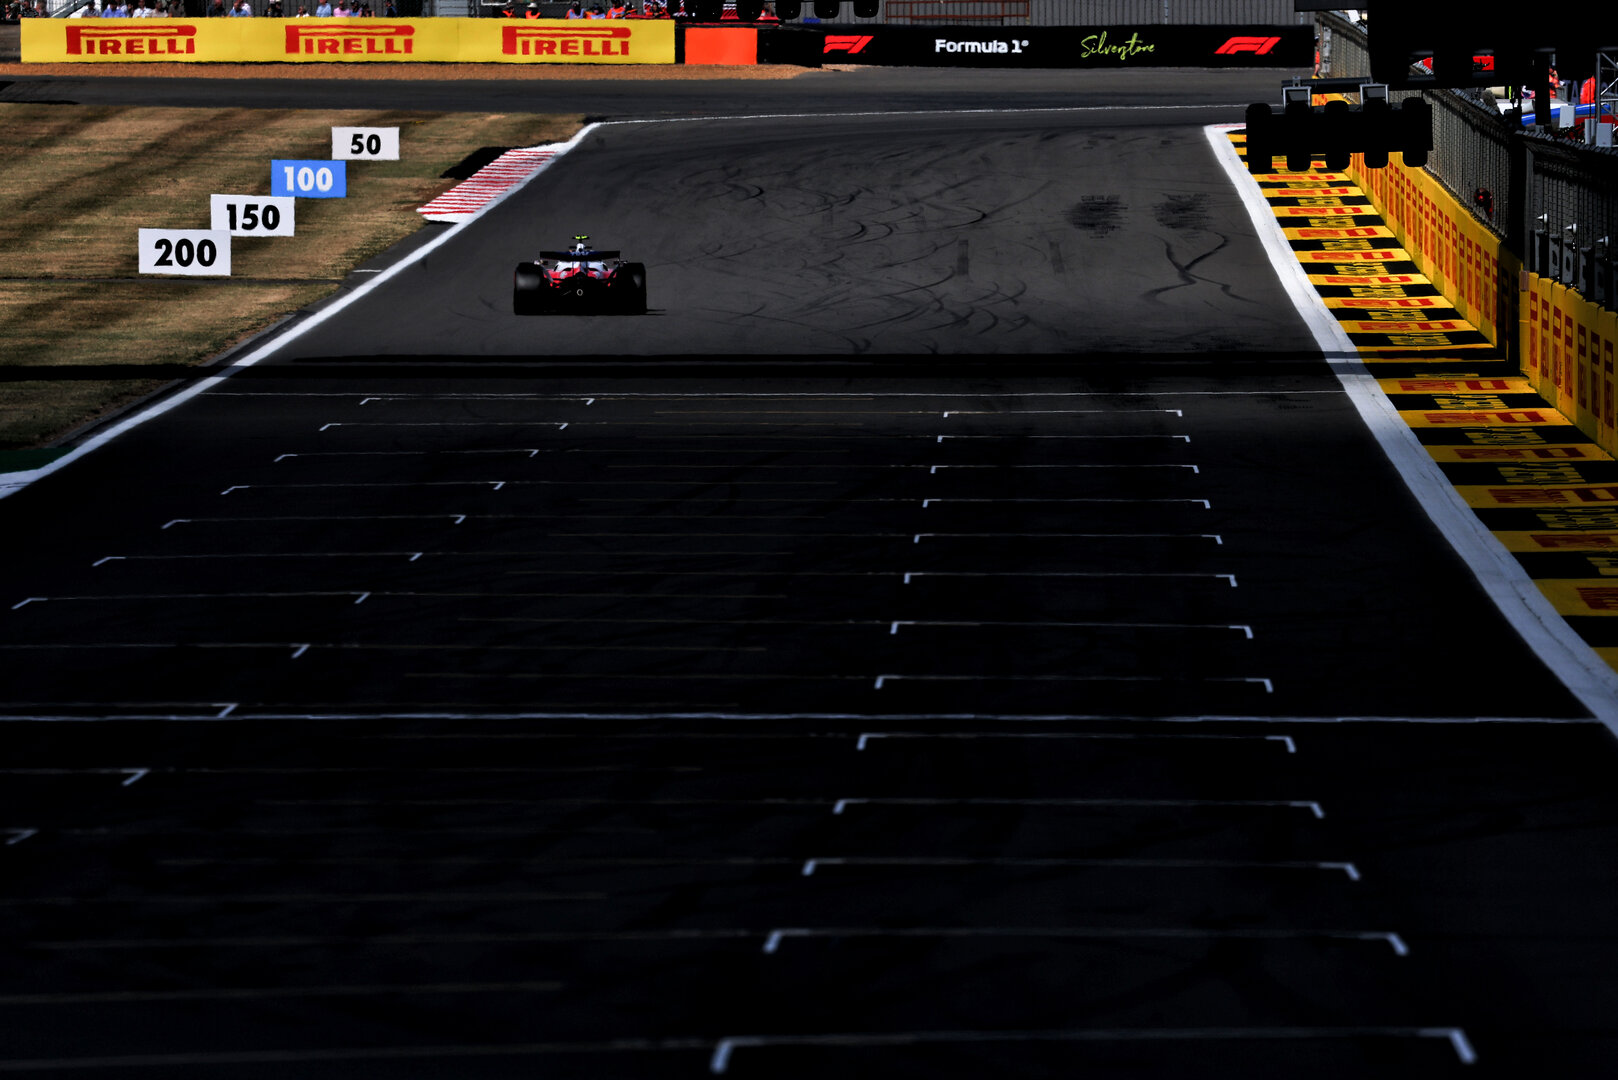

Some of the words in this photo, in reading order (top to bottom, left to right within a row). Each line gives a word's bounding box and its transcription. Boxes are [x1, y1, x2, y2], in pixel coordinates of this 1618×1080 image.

[66, 24, 196, 54] PIRELLI
[285, 24, 415, 55] PIRELLI
[502, 26, 632, 56] PIRELLI
[933, 38, 1008, 54] Formula
[1080, 30, 1156, 61] Silverstone
[350, 133, 381, 155] 50
[283, 165, 334, 192] 100
[226, 203, 280, 231] 150
[153, 238, 217, 267] 200
